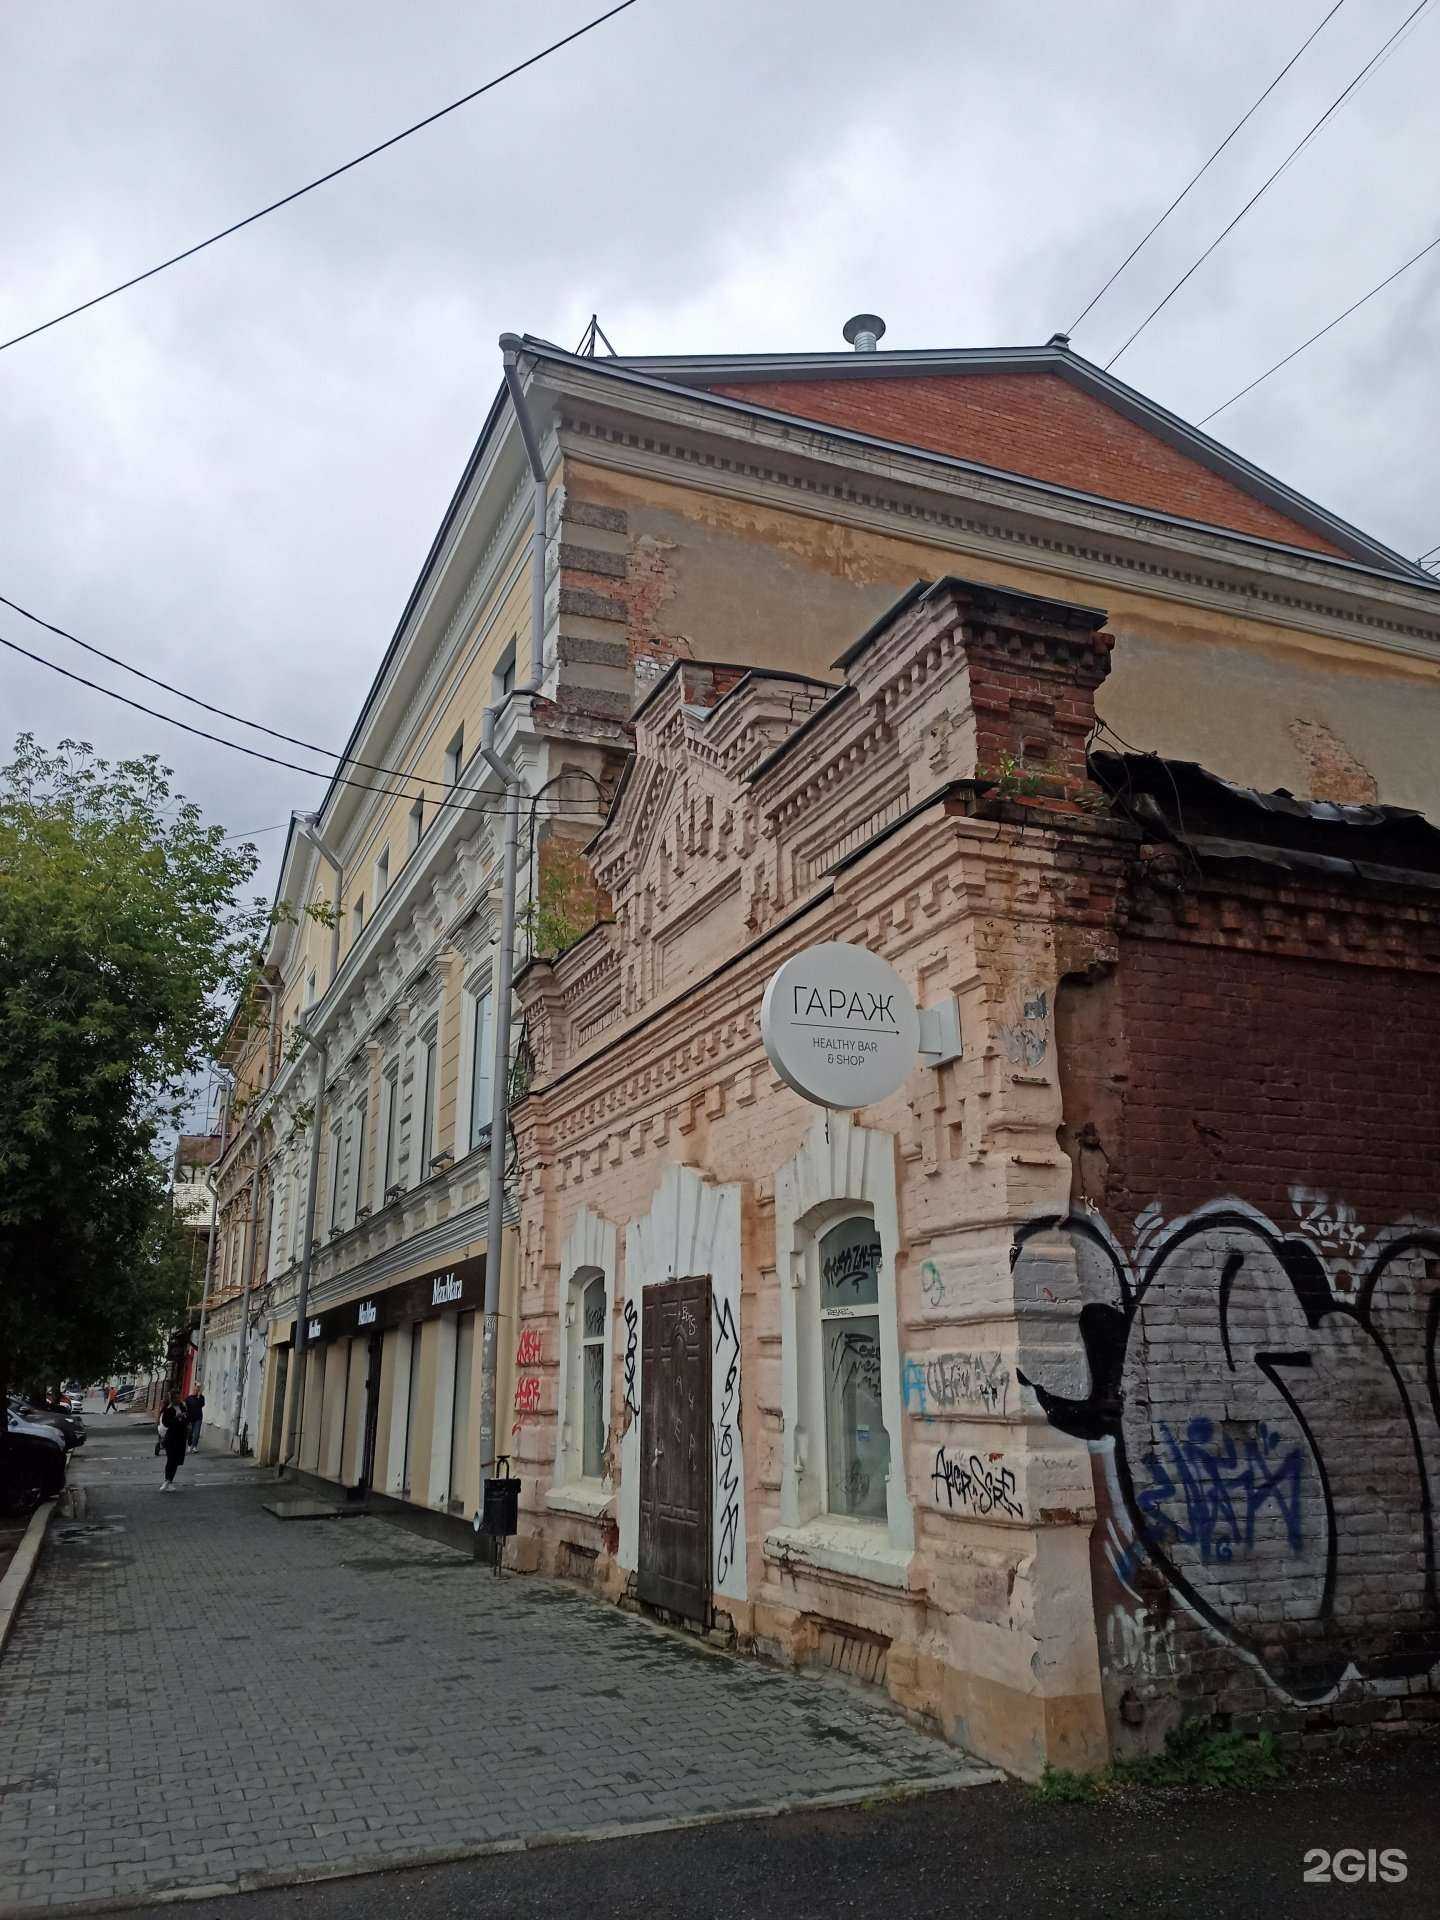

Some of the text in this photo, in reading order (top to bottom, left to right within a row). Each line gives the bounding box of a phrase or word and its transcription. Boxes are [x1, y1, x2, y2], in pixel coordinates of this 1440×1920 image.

[794, 985, 896, 1024] ГАРАЖ
[812, 1037, 878, 1053] HEALTHY BAR
[836, 1054, 865, 1066] SHOP
